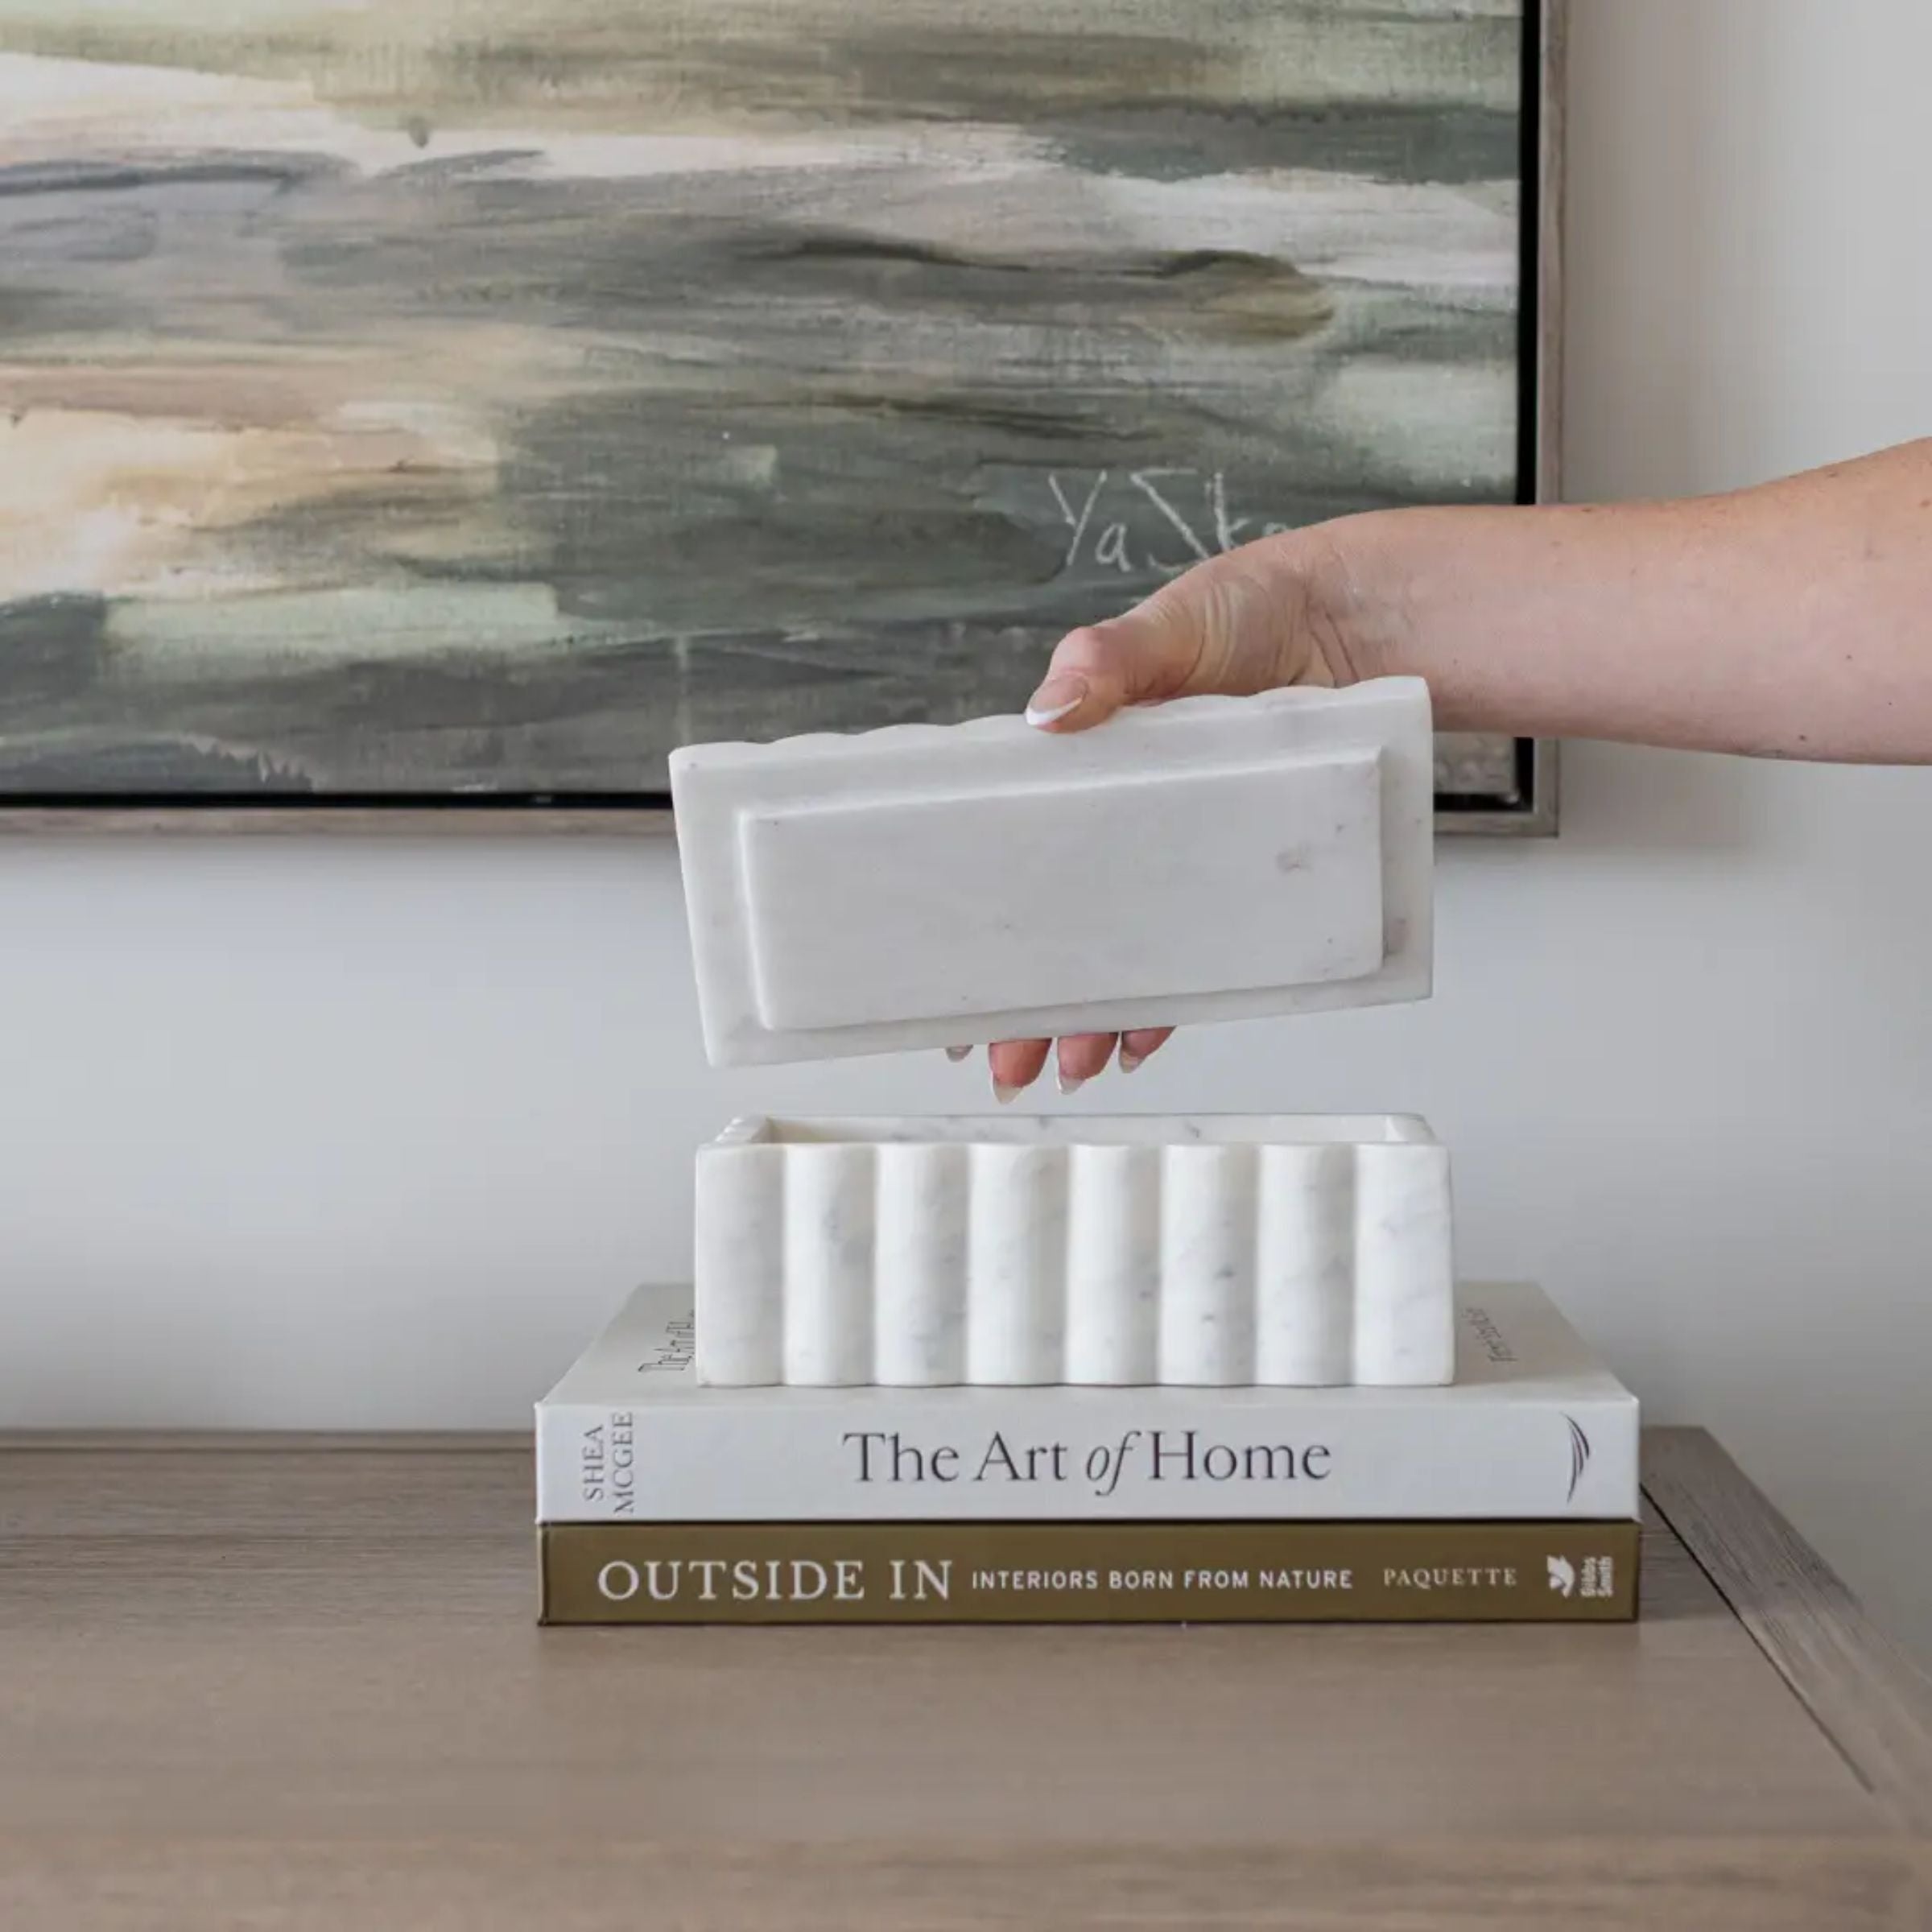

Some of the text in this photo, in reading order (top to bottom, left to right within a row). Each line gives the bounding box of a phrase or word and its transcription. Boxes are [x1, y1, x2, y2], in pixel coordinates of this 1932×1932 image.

[583, 1424, 605, 1501] SHEA
[612, 1411, 634, 1513] MCGEE
[842, 1430, 1331, 1496] The Art of Home
[597, 1559, 953, 1600] OUTSIDE IN
[972, 1569, 1352, 1590] INTERIORS BORN FROM NATURE
[1383, 1567, 1517, 1590] PAQUETTE
